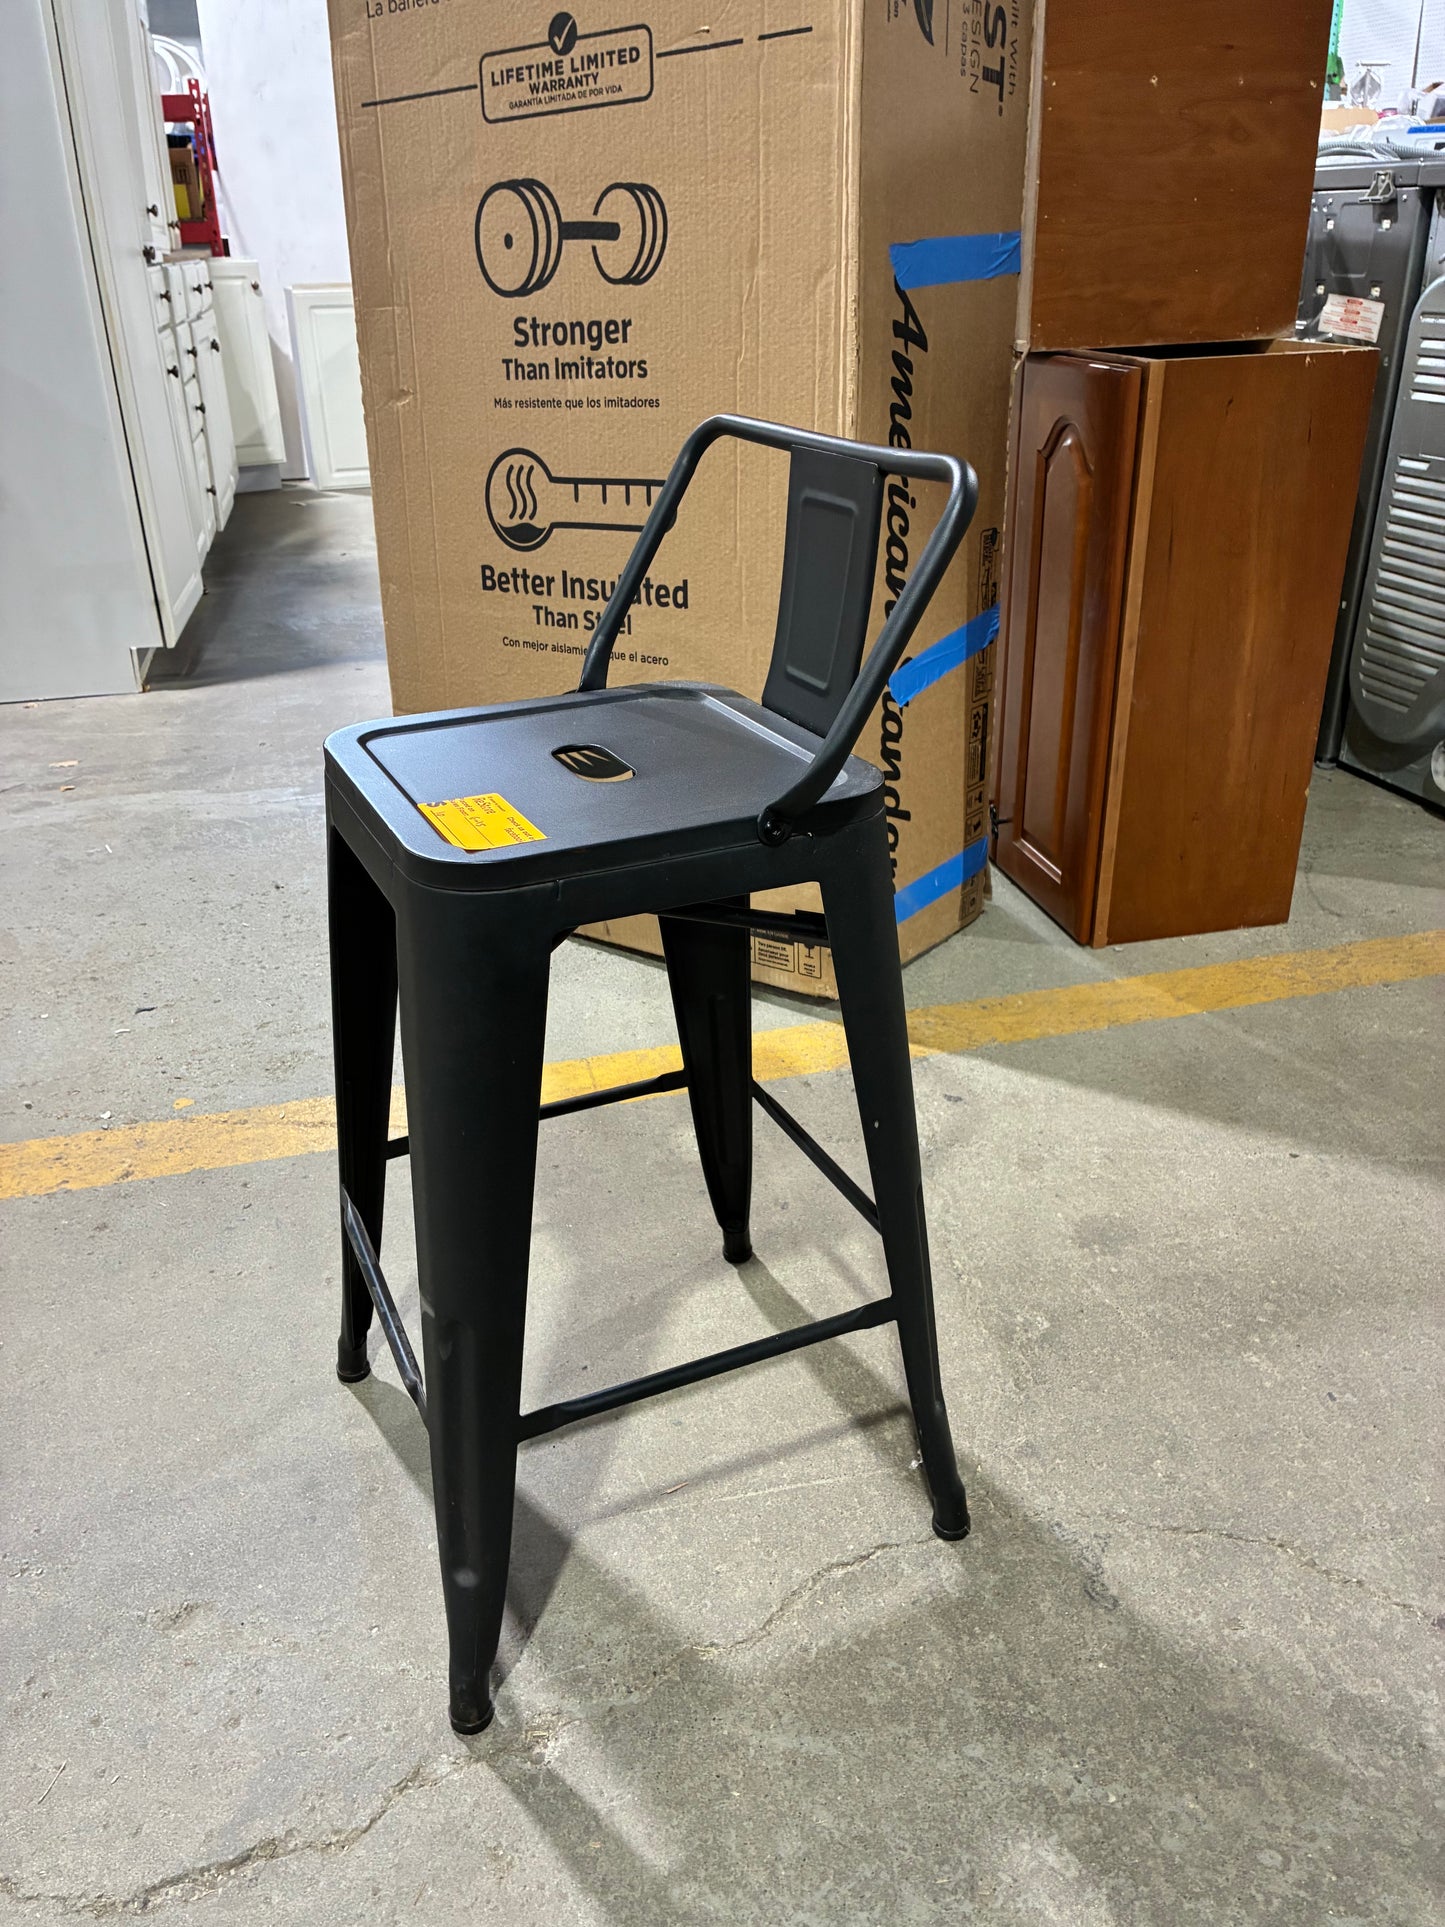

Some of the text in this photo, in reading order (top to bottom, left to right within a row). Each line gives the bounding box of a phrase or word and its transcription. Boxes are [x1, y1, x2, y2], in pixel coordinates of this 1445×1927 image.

[366, 0, 383, 18] La
[960, 21, 968, 77] capas
[491, 46, 640, 87] LIFETIME LIMITED
[1008, 39, 1019, 96] With
[529, 72, 599, 95] WARRANTY
[545, 92, 577, 105] LIMITADA
[578, 90, 588, 99] DE
[589, 87, 604, 98] POR
[605, 85, 623, 95] VIDA
[513, 315, 632, 351] Stronger
[502, 355, 648, 381] Than Imitators
[494, 396, 660, 411] Más resistente que los imitadores
[885, 275, 928, 621] Ameican
[480, 564, 689, 609] Better Insuted
[532, 605, 632, 635] Than Sel
[502, 636, 521, 648] Con
[523, 639, 549, 653] mejor
[628, 651, 638, 662] el
[640, 654, 669, 666] acero
